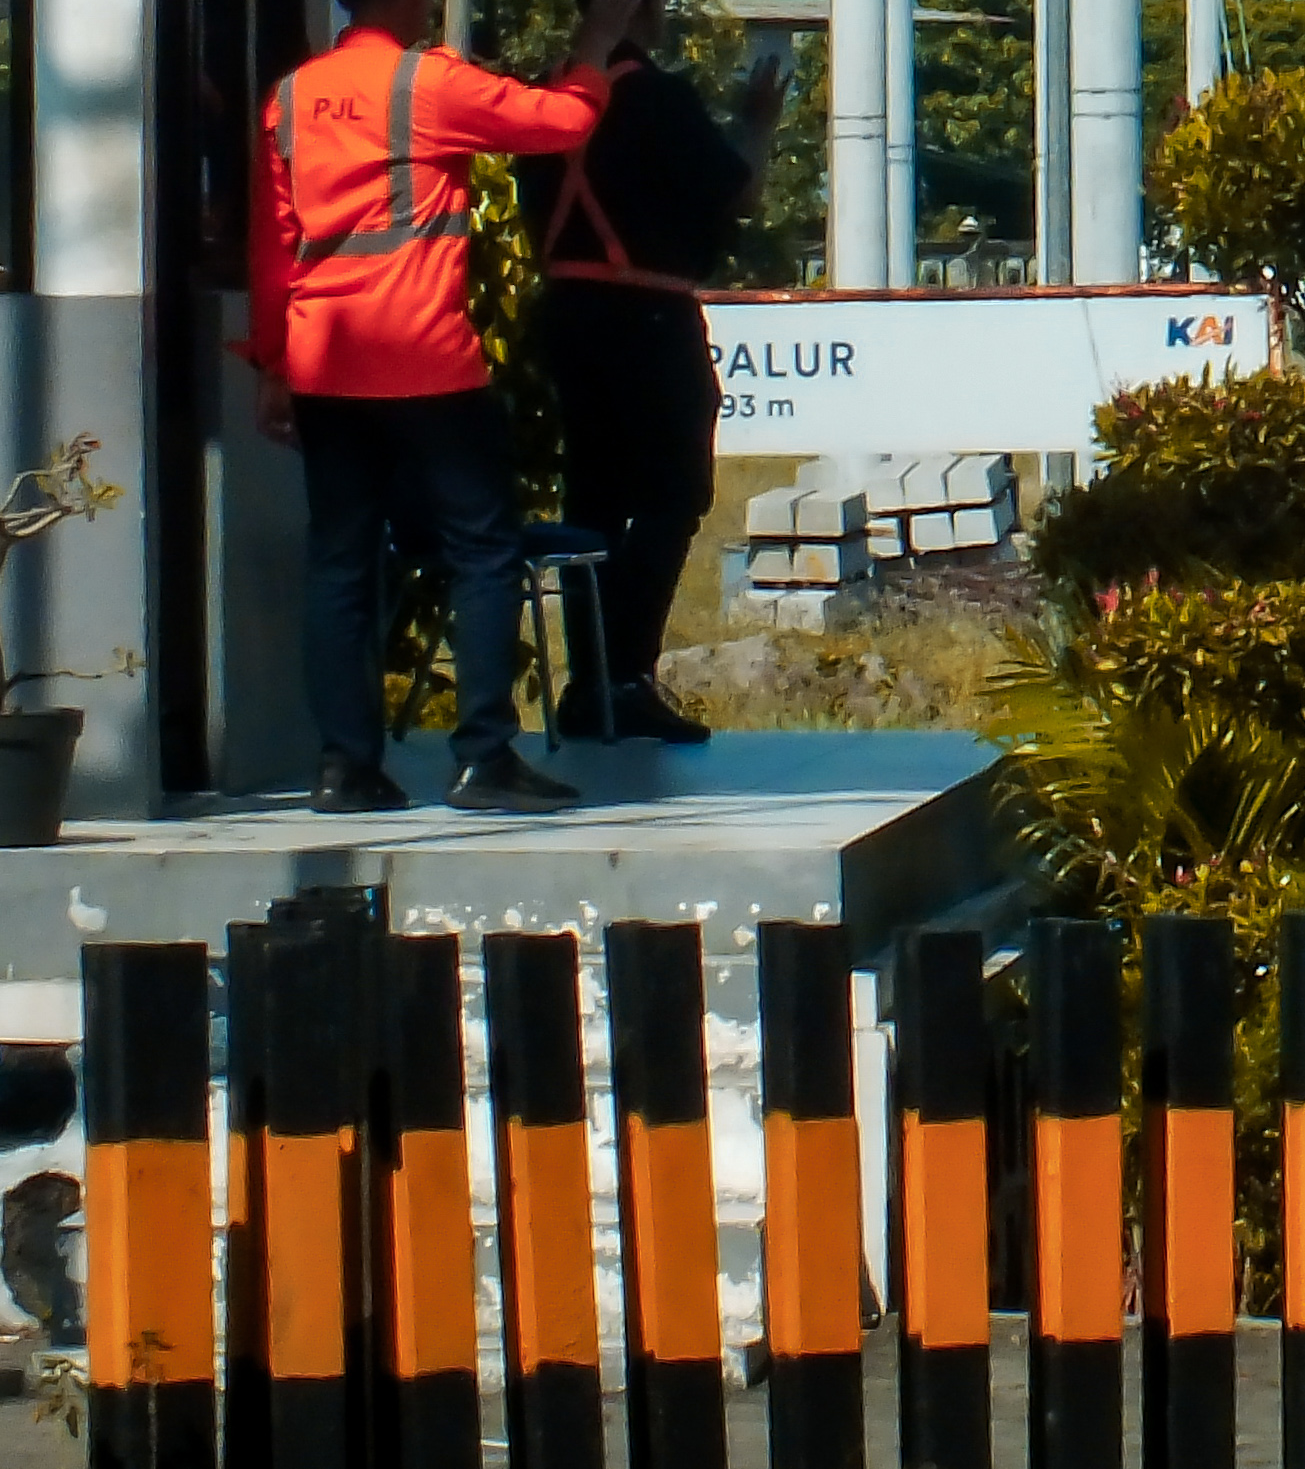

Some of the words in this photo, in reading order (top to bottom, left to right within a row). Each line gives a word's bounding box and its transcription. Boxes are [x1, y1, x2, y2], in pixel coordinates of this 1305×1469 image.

[313, 97, 362, 121] PJL
[1167, 315, 1235, 346] KAI
[768, 398, 794, 417] m
